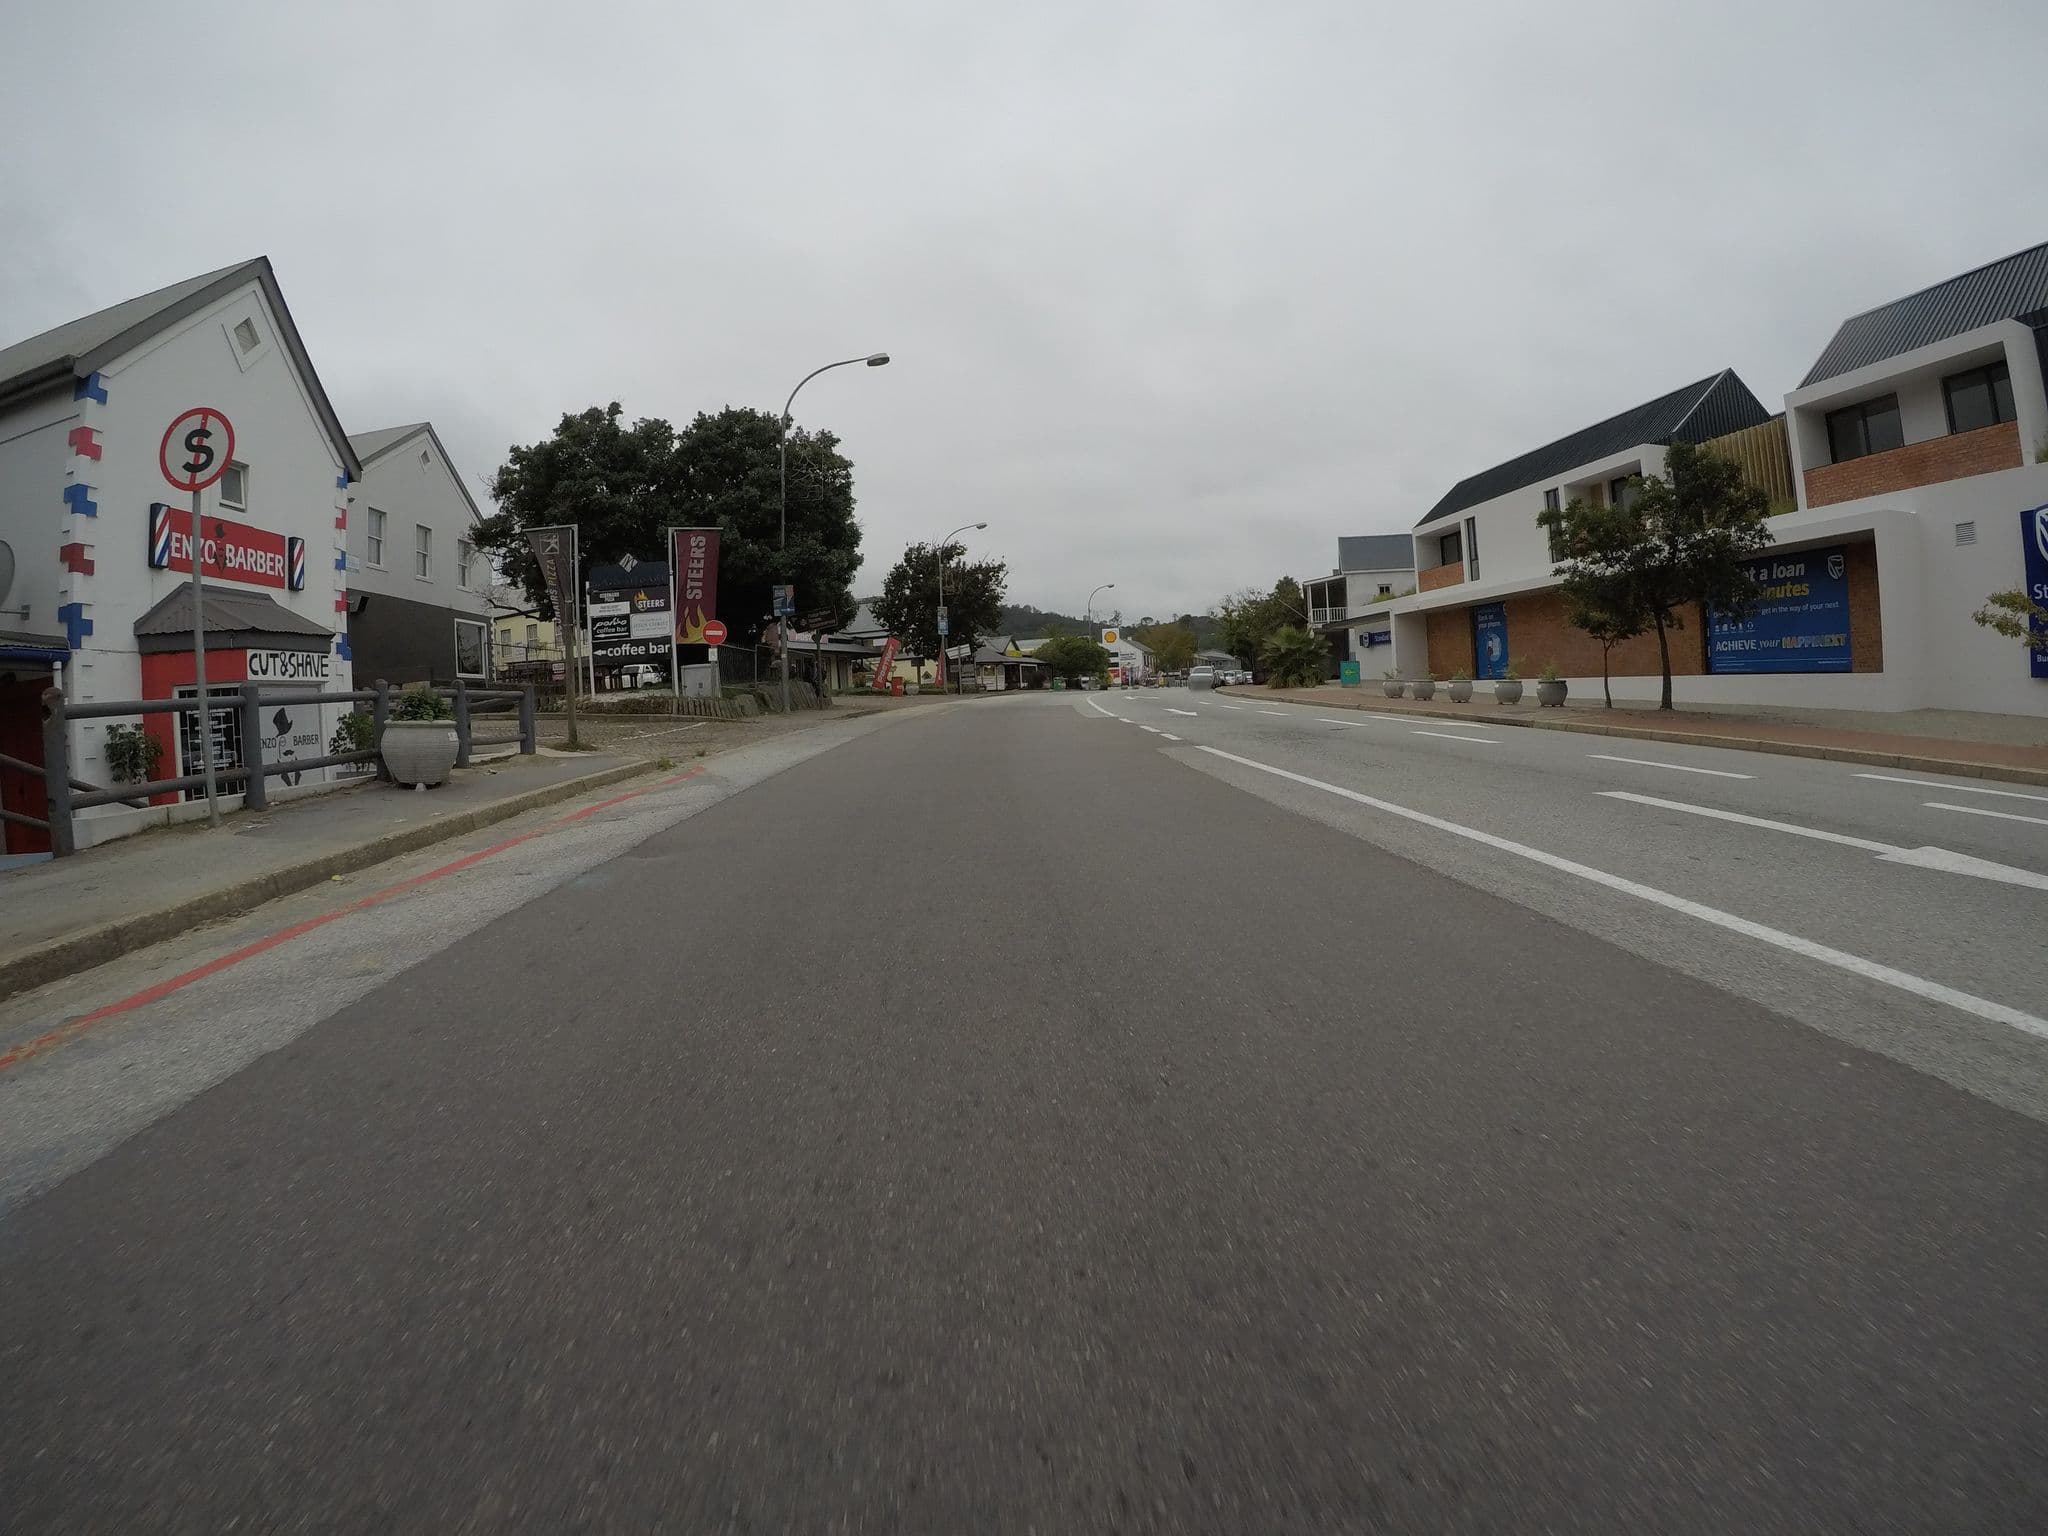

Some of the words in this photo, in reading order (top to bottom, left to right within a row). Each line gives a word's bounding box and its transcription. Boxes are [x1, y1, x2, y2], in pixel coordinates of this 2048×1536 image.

[183, 429, 214, 473] S
[225, 544, 285, 577] BARBER
[686, 535, 706, 600] STEERS
[546, 558, 557, 586] PIZZA
[1742, 566, 1757, 582] et
[1759, 568, 1768, 581] a
[1773, 563, 1805, 579] loan
[638, 599, 665, 609] STEERS
[1810, 603, 1824, 612] your
[607, 644, 646, 657] coffee
[649, 642, 670, 654] bar
[1715, 640, 1757, 651] ACHIEVE
[1758, 640, 1780, 650] your
[248, 651, 329, 679] CUT&SHAVE
[260, 737, 276, 749] NZO
[293, 734, 320, 747] BARBER
